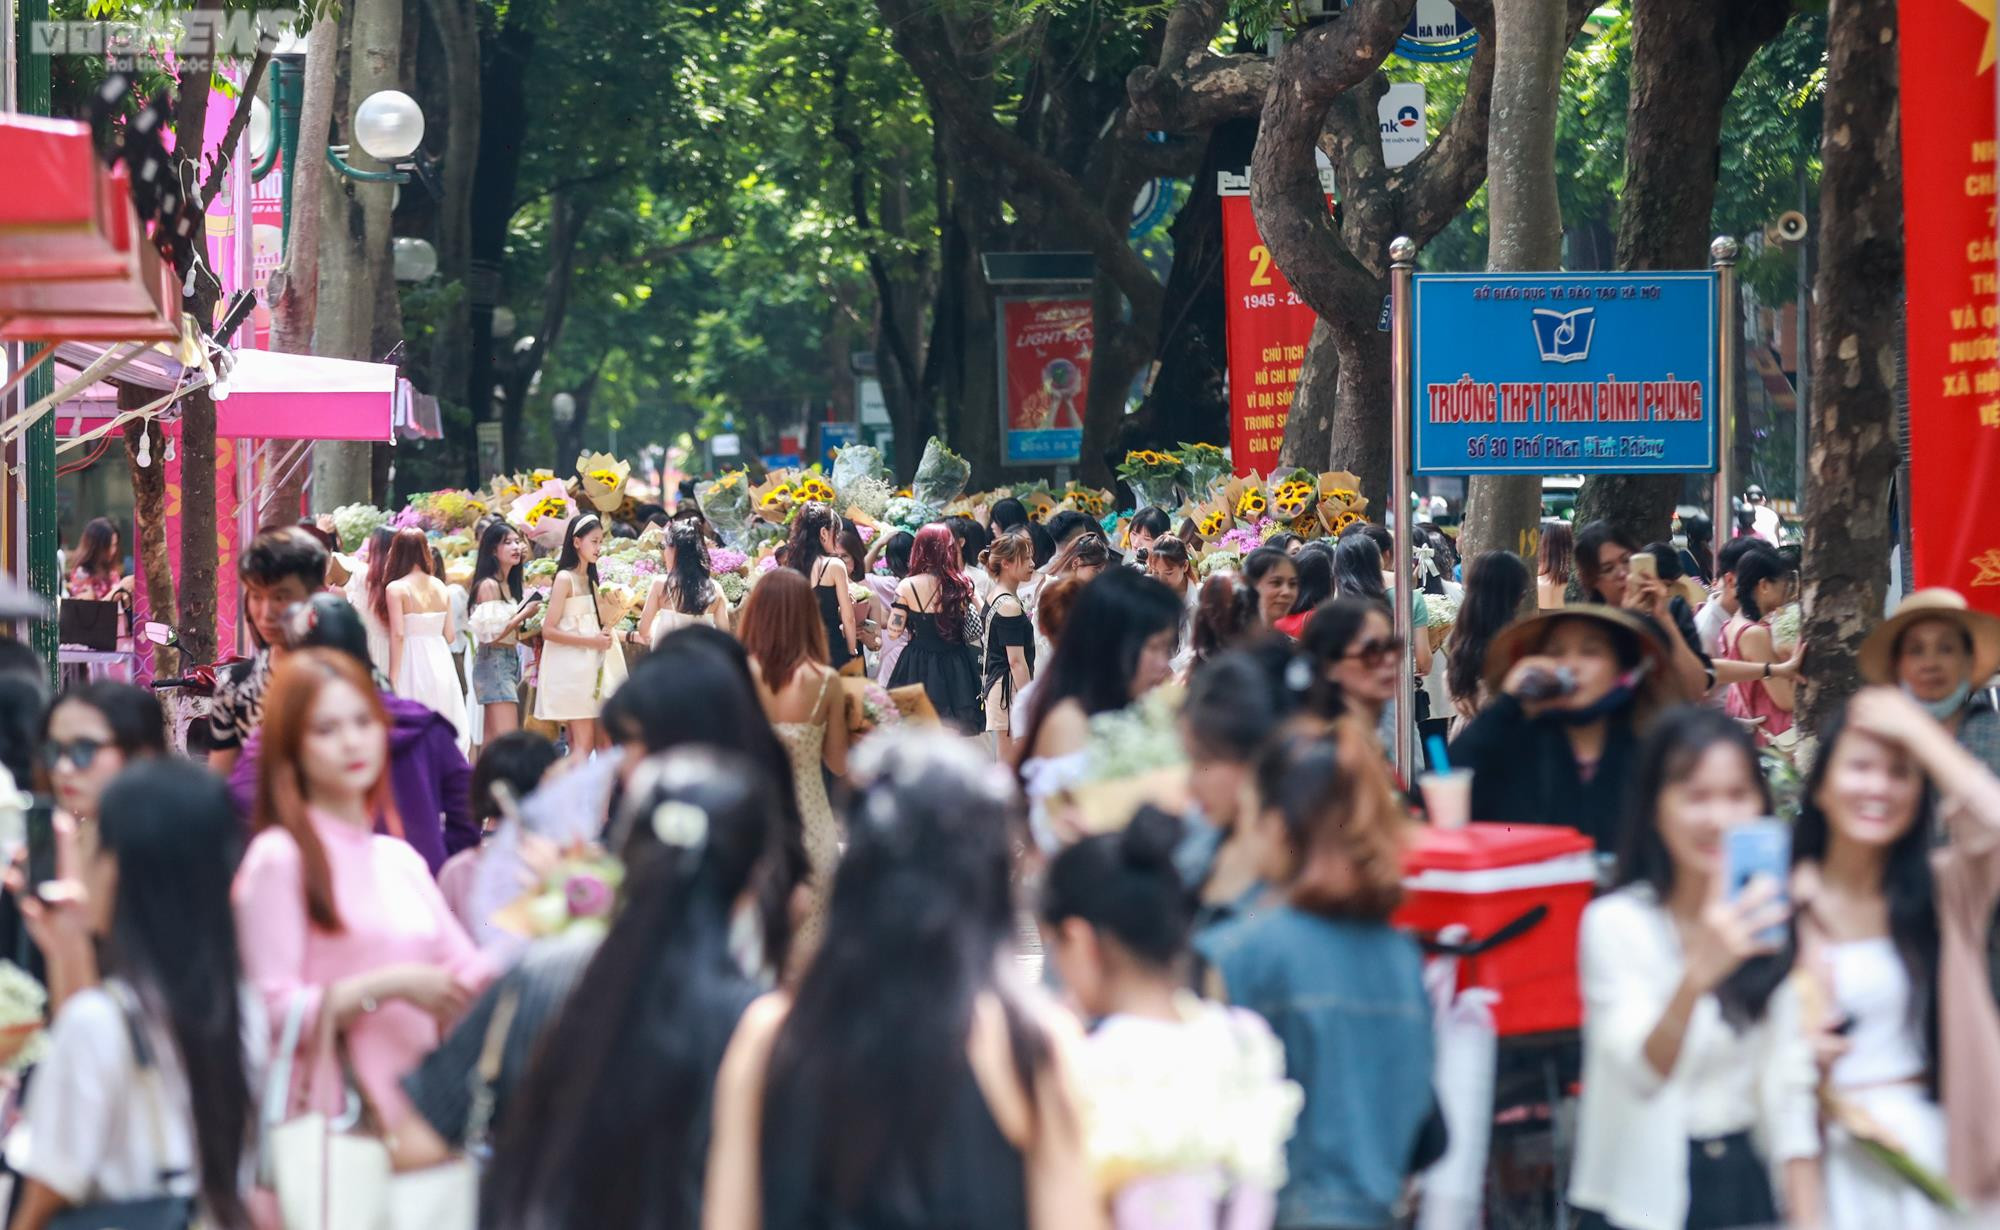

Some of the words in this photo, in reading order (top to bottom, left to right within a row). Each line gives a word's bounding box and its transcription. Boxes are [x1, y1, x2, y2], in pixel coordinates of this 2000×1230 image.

[1418, 25, 1433, 37] HÀ
[1436, 23, 1455, 39] NỘI
[1243, 293, 1275, 308] 1945
[1473, 284, 1491, 299] SỞ
[1493, 284, 1520, 299] GIÁO
[1522, 286, 1546, 301] DỤC
[1550, 284, 1565, 299] VÀ
[1567, 285, 1592, 299] ĐÀO
[1595, 286, 1618, 301] TẠO
[1620, 284, 1637, 299] HÀ
[1640, 285, 1661, 300] NỘI
[1262, 341, 1281, 362] CHỦ
[1283, 345, 1304, 364] TỊCH
[1255, 366, 1268, 385] HỒ
[1270, 366, 1286, 384] CHÍ
[1258, 392, 1274, 410] ĐẠI
[1427, 373, 1497, 424] TRƯỜNG
[1499, 382, 1543, 423] THPT
[1545, 383, 1594, 422] PHAN
[1596, 373, 1641, 422] ĐÌNH
[1642, 373, 1703, 422] PHÙNG
[1244, 414, 1275, 431] TRONG
[1249, 432, 1268, 453] CỦA
[1467, 433, 1489, 458] Số
[1491, 438, 1508, 458] 30
[1513, 433, 1544, 458] Phố
